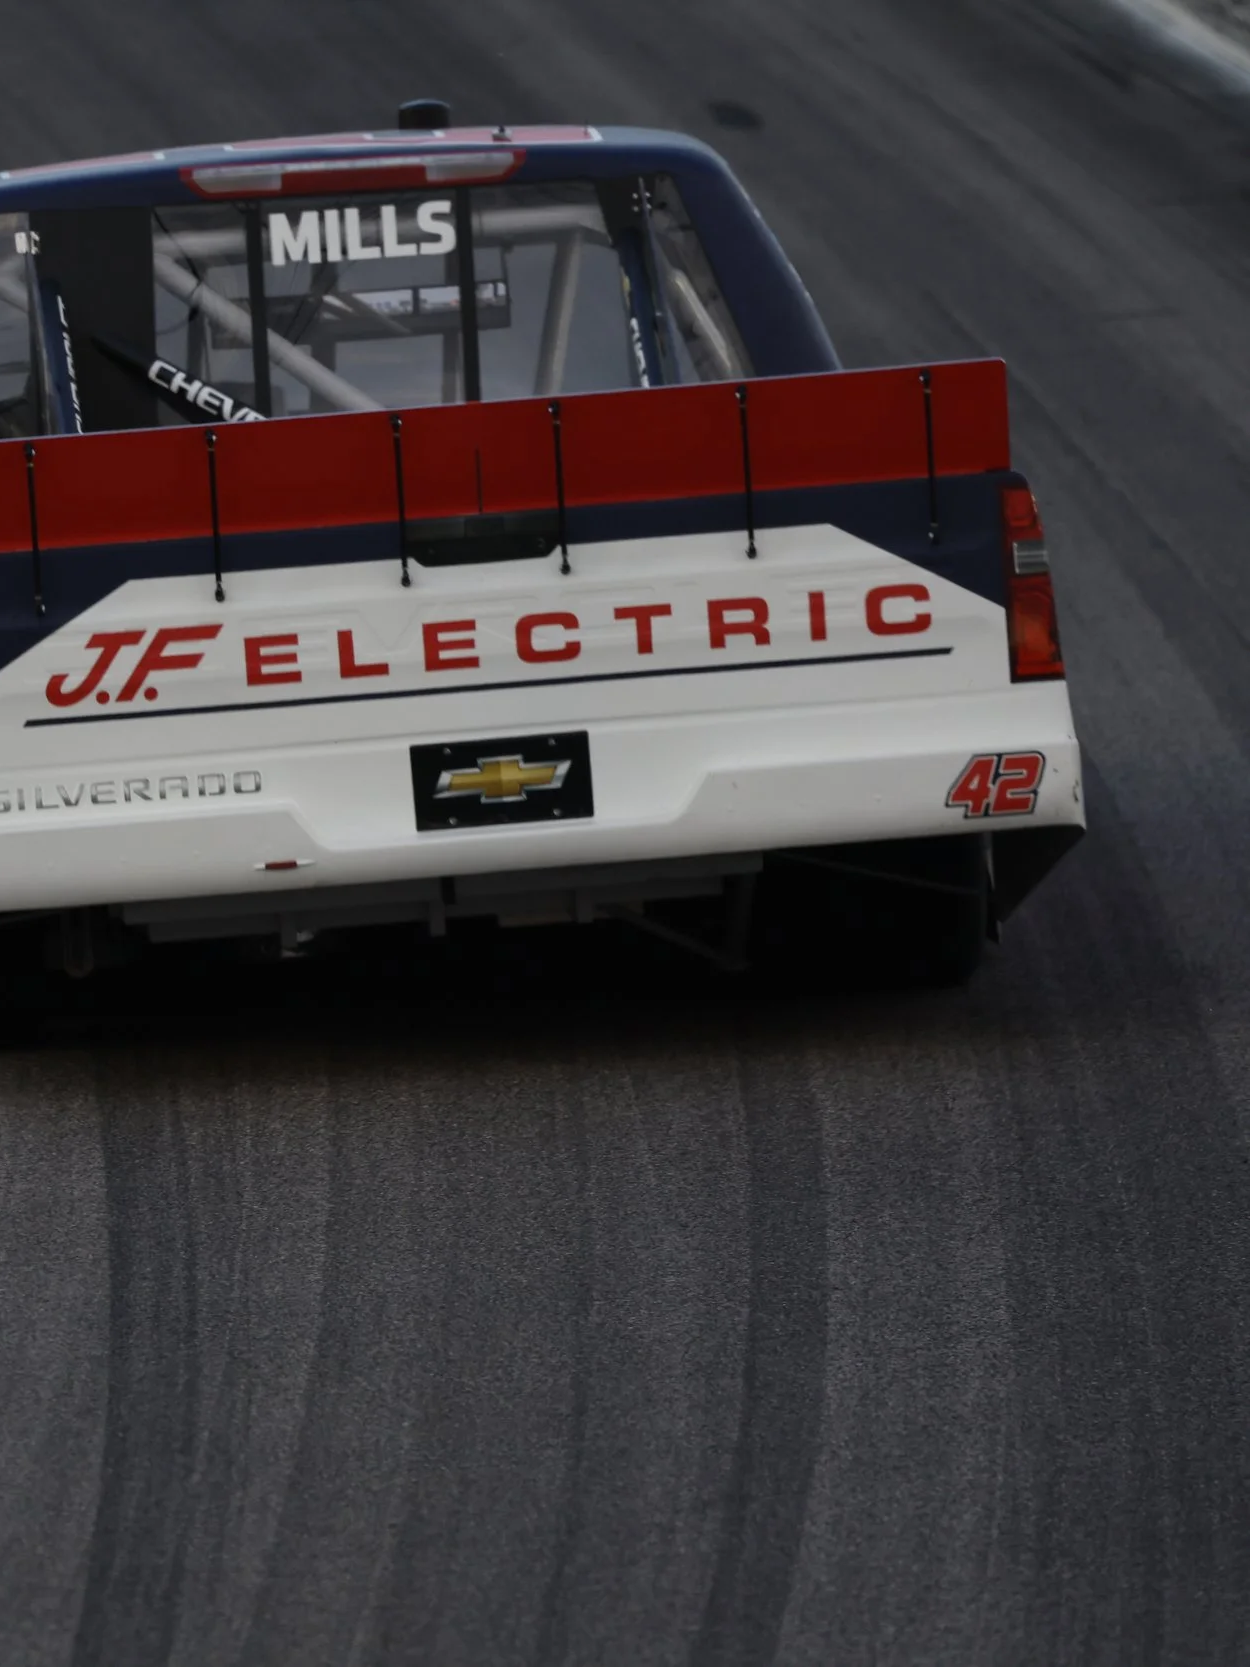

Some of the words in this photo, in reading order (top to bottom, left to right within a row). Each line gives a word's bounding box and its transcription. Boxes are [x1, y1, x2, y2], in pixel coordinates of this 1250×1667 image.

[268, 199, 457, 266] MILLS
[147, 359, 268, 422] CHEV
[46, 624, 224, 707] J.F.
[244, 583, 933, 687] ELECTRIC
[945, 751, 1046, 819] 42
